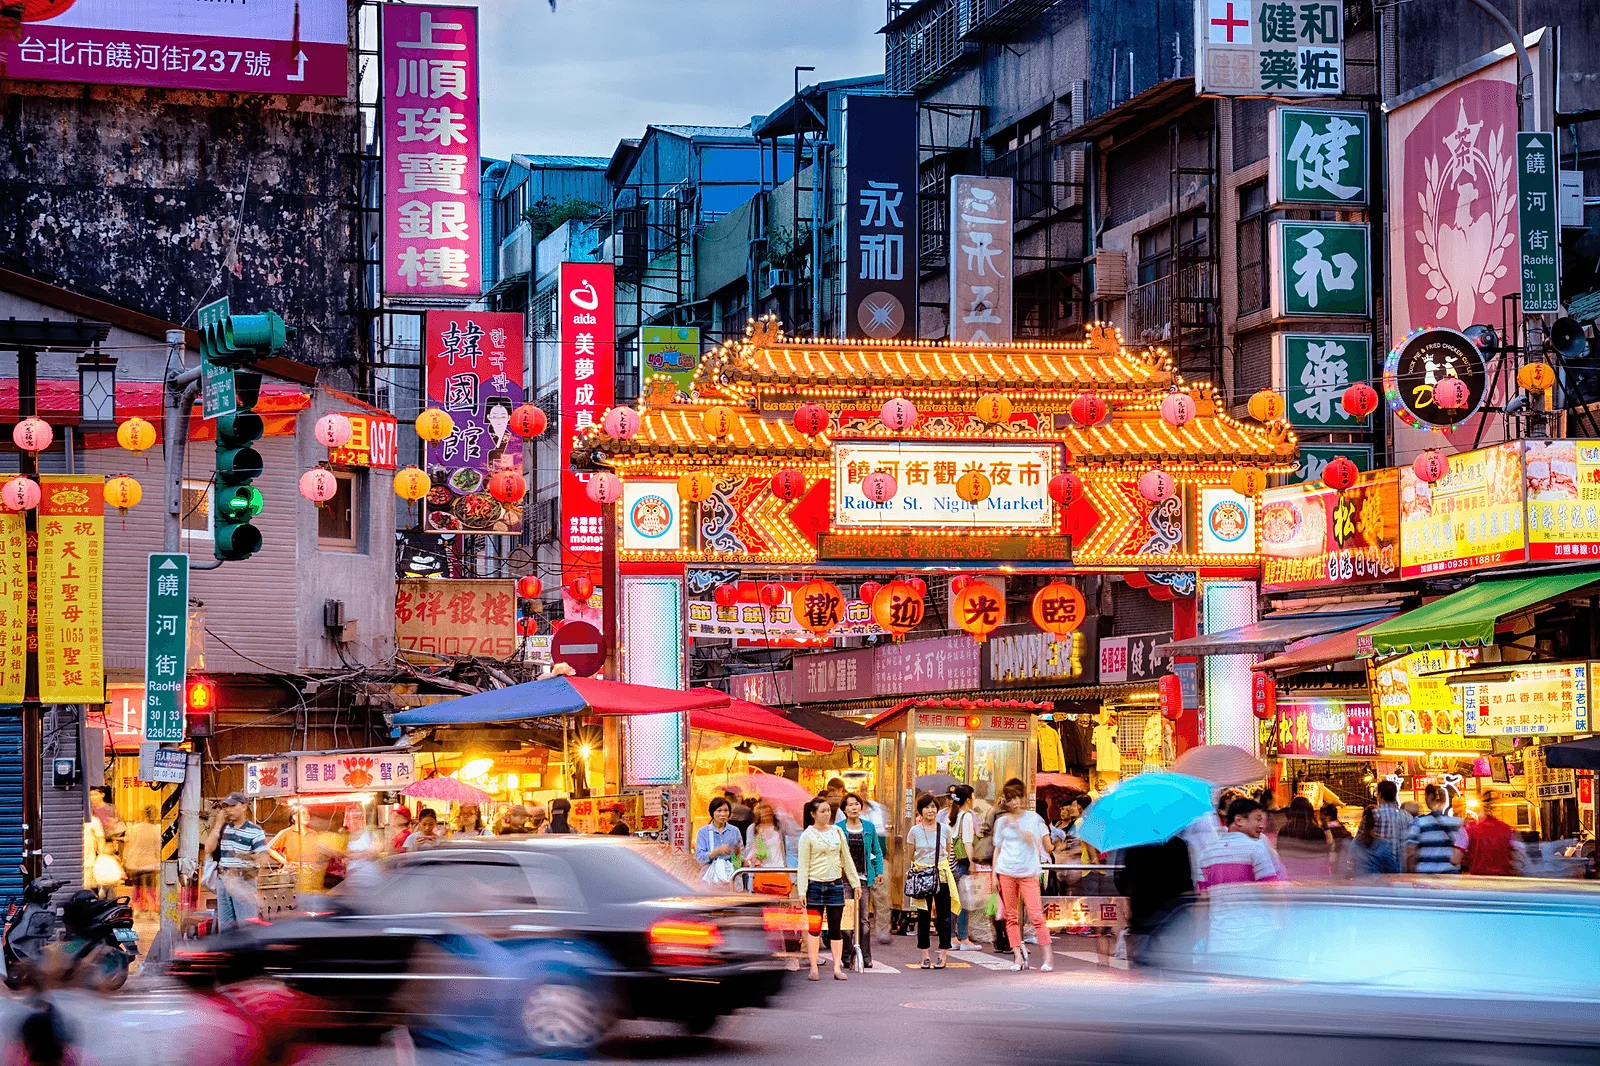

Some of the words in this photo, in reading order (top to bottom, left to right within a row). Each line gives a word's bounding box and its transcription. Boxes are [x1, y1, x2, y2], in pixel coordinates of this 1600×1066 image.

[1259, 2, 1338, 44] 健和
[18, 36, 271, 77] 台北市饒河街237號
[1259, 50, 1339, 90] 藥粧
[396, 11, 470, 289] 上順珠寶銀樓
[1287, 117, 1363, 199] 健
[1525, 152, 1549, 251] 饒河街
[860, 180, 904, 281] 永和
[1292, 229, 1358, 308] 和
[1523, 254, 1554, 265] RaoHe
[1523, 268, 1537, 279] St.
[1524, 300, 1540, 310] 226
[1542, 299, 1558, 310] 255
[1525, 283, 1536, 293] 30
[1544, 282, 1555, 293] 33
[573, 313, 597, 325] aida
[1413, 351, 1422, 361] PIE
[1425, 342, 1441, 351] FRIED
[1442, 343, 1464, 358] CHICKEN
[438, 320, 484, 462] 韓國館
[1295, 341, 1352, 423] 藥
[370, 420, 397, 465] 097
[903, 495, 923, 510] St.
[933, 496, 978, 513] Nigh
[987, 496, 1044, 510] Market
[45, 520, 96, 537] 恭祝
[155, 574, 179, 676] 饒河街
[689, 602, 870, 624] 節暨饒河市
[804, 592, 839, 627] 歡
[888, 595, 919, 627] 迎
[964, 594, 999, 625] 光
[1042, 596, 1076, 624] 臨
[904, 649, 946, 683] 三禾百貨
[149, 680, 182, 691] RaoHe
[149, 695, 162, 706] St.
[1574, 666, 1587, 731] 實在老口味
[114, 698, 145, 736] 上
[150, 710, 160, 720] 30
[169, 710, 180, 720] 33
[918, 714, 967, 728] 媽祖廟口
[990, 716, 1028, 730] 服務台
[147, 728, 163, 738] 226
[166, 728, 182, 738] 255
[674, 824, 684, 854] 禁止進入
